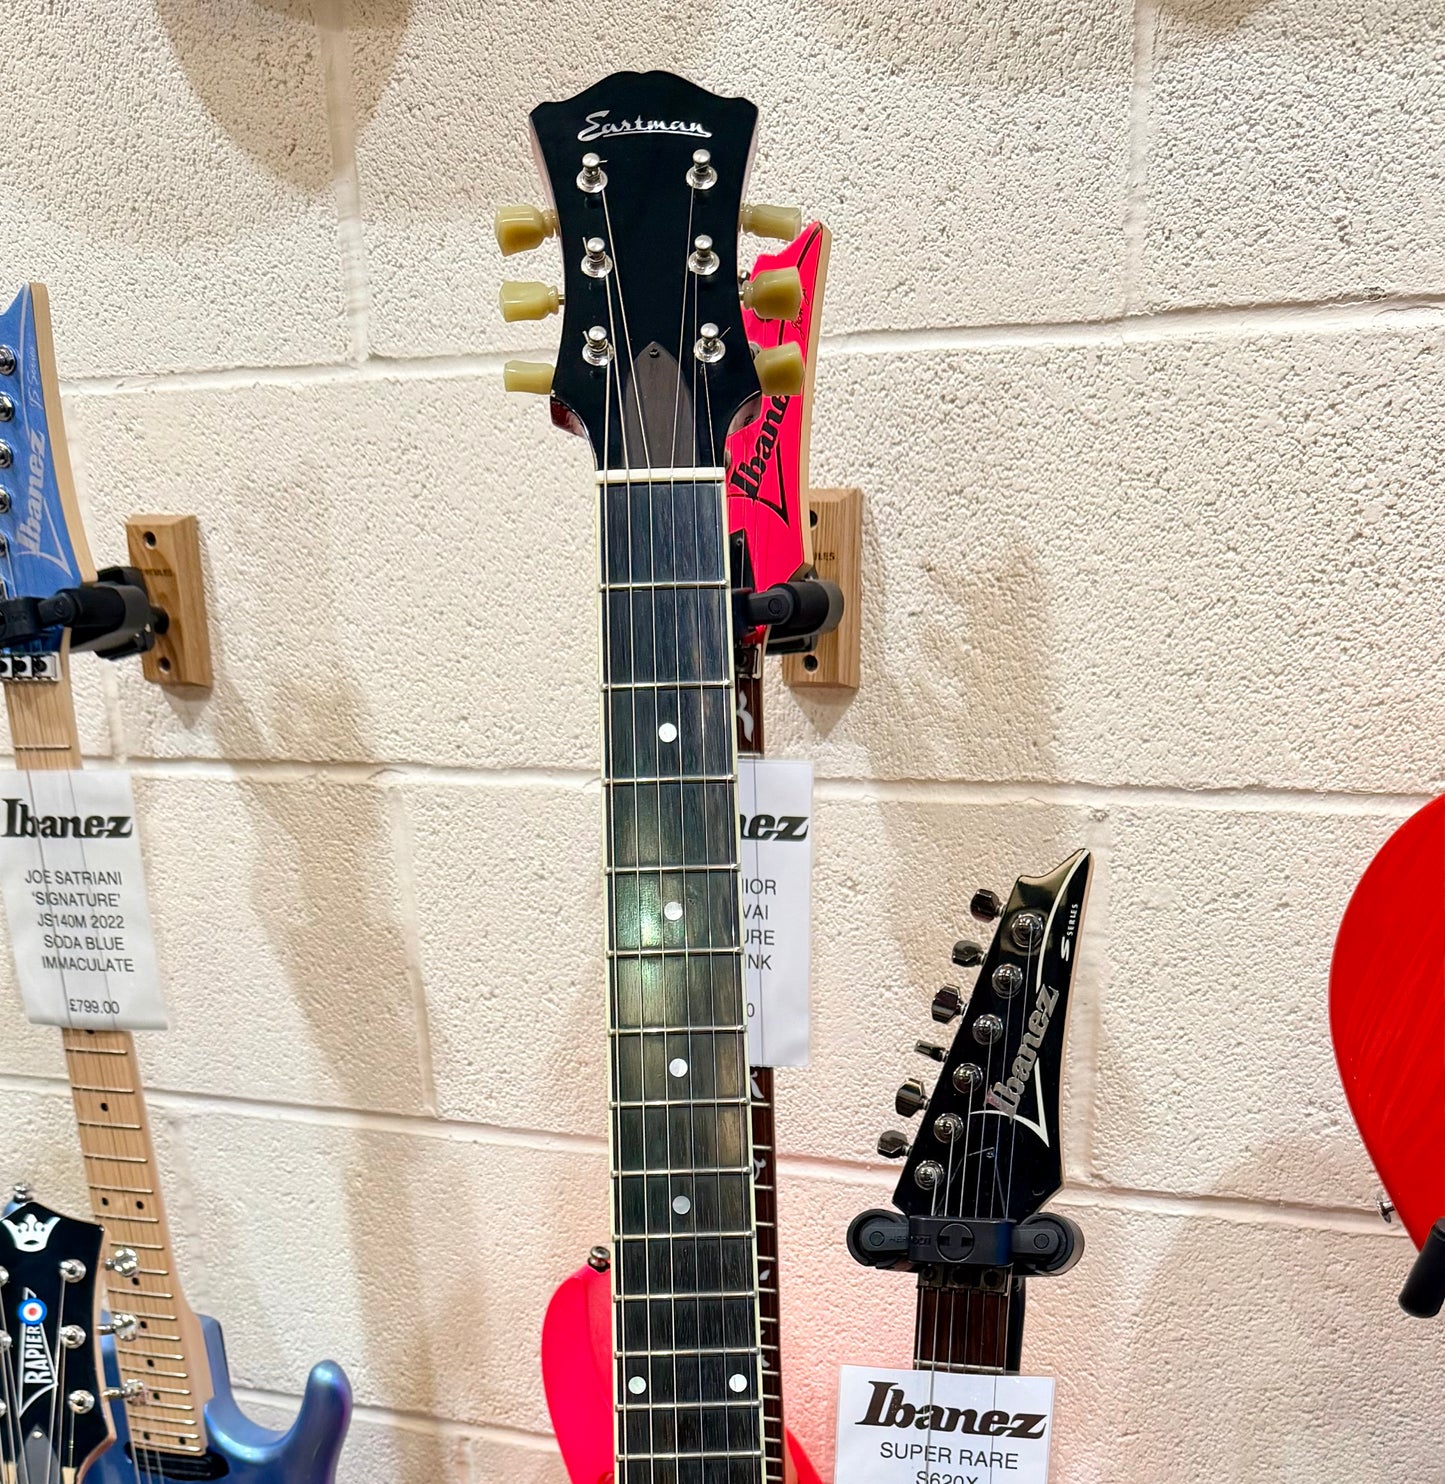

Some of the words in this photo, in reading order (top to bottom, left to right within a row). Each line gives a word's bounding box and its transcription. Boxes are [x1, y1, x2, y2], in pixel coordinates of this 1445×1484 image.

[577, 110, 712, 142] Eastman
[731, 395, 790, 500] Ibane
[16, 428, 46, 557] Ibanez
[1, 798, 133, 838] Ibanez
[25, 870, 51, 886] JOE
[56, 871, 122, 886] SATRIANI
[742, 878, 777, 895] IOR
[37, 914, 87, 928] JS140M
[91, 915, 124, 929] 2022
[743, 904, 769, 920] VAI
[1066, 903, 1079, 936] SERIES
[44, 935, 82, 949] SODA
[86, 936, 124, 950] BLUE
[42, 956, 134, 973] IMMACULATE
[70, 999, 120, 1014] £799.00
[983, 983, 1060, 1125] Ibanez
[24, 1325, 53, 1384] RAPIER
[854, 1380, 1049, 1440] Ibanez
[879, 1441, 952, 1465] SUPER
[958, 1448, 1020, 1470] RARE
